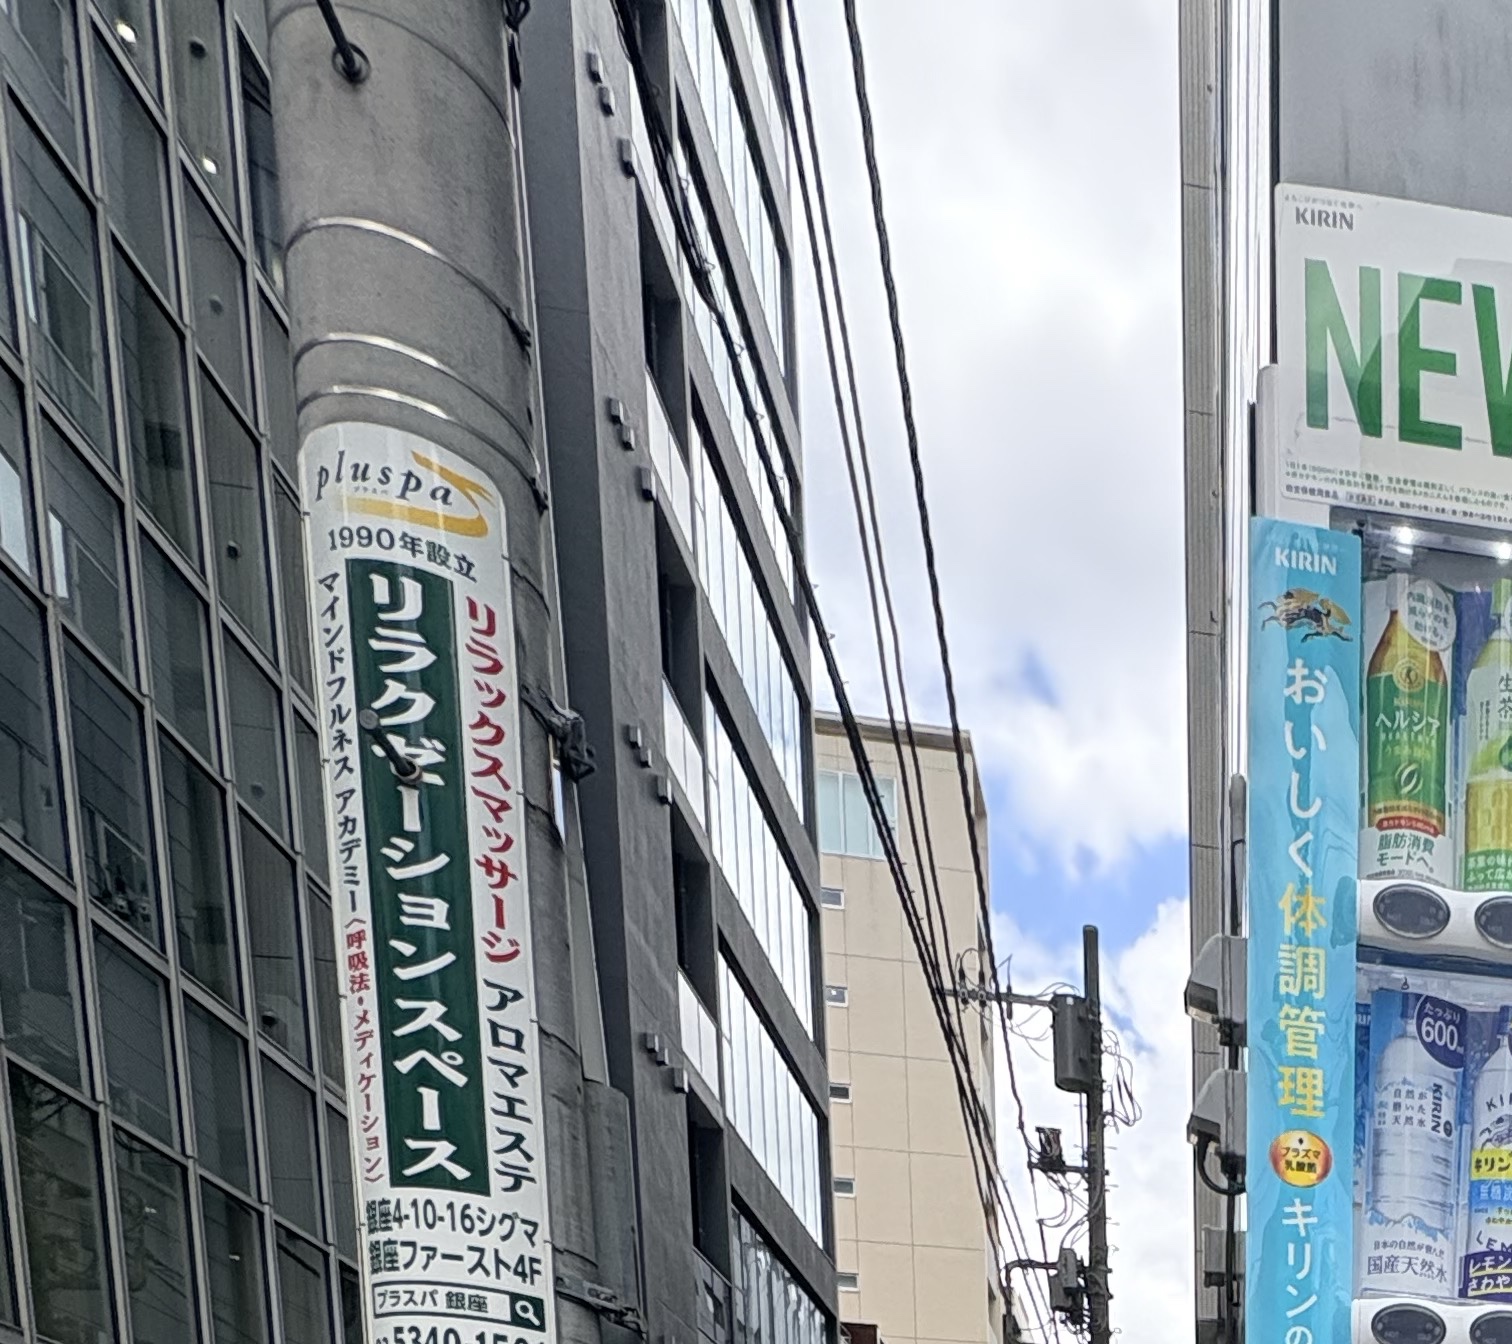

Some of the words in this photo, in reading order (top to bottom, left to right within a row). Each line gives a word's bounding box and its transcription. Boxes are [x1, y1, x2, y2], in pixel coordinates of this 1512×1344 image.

[1295, 206, 1353, 231] KIRIN
[315, 449, 454, 508] pluspa
[328, 526, 478, 583] 1990年設立
[1274, 546, 1337, 576] KIRIN
[317, 572, 355, 781] マインドフルネス
[1375, 709, 1441, 737] ヘルシア
[465, 596, 522, 963] リラックスマッサージ
[1378, 832, 1435, 857] 脂肪消費
[1278, 658, 1328, 1119] おいしく体調管理
[1424, 1002, 1461, 1025] たっぷり
[482, 978, 538, 1193] アロマエステ
[1431, 1082, 1444, 1134] KIRIN
[369, 1237, 543, 1287] 銀座ファースト4F
[1367, 1254, 1448, 1284] 国産天然水
[376, 1290, 438, 1310] プラスパ
[445, 1291, 489, 1315] 銀座
